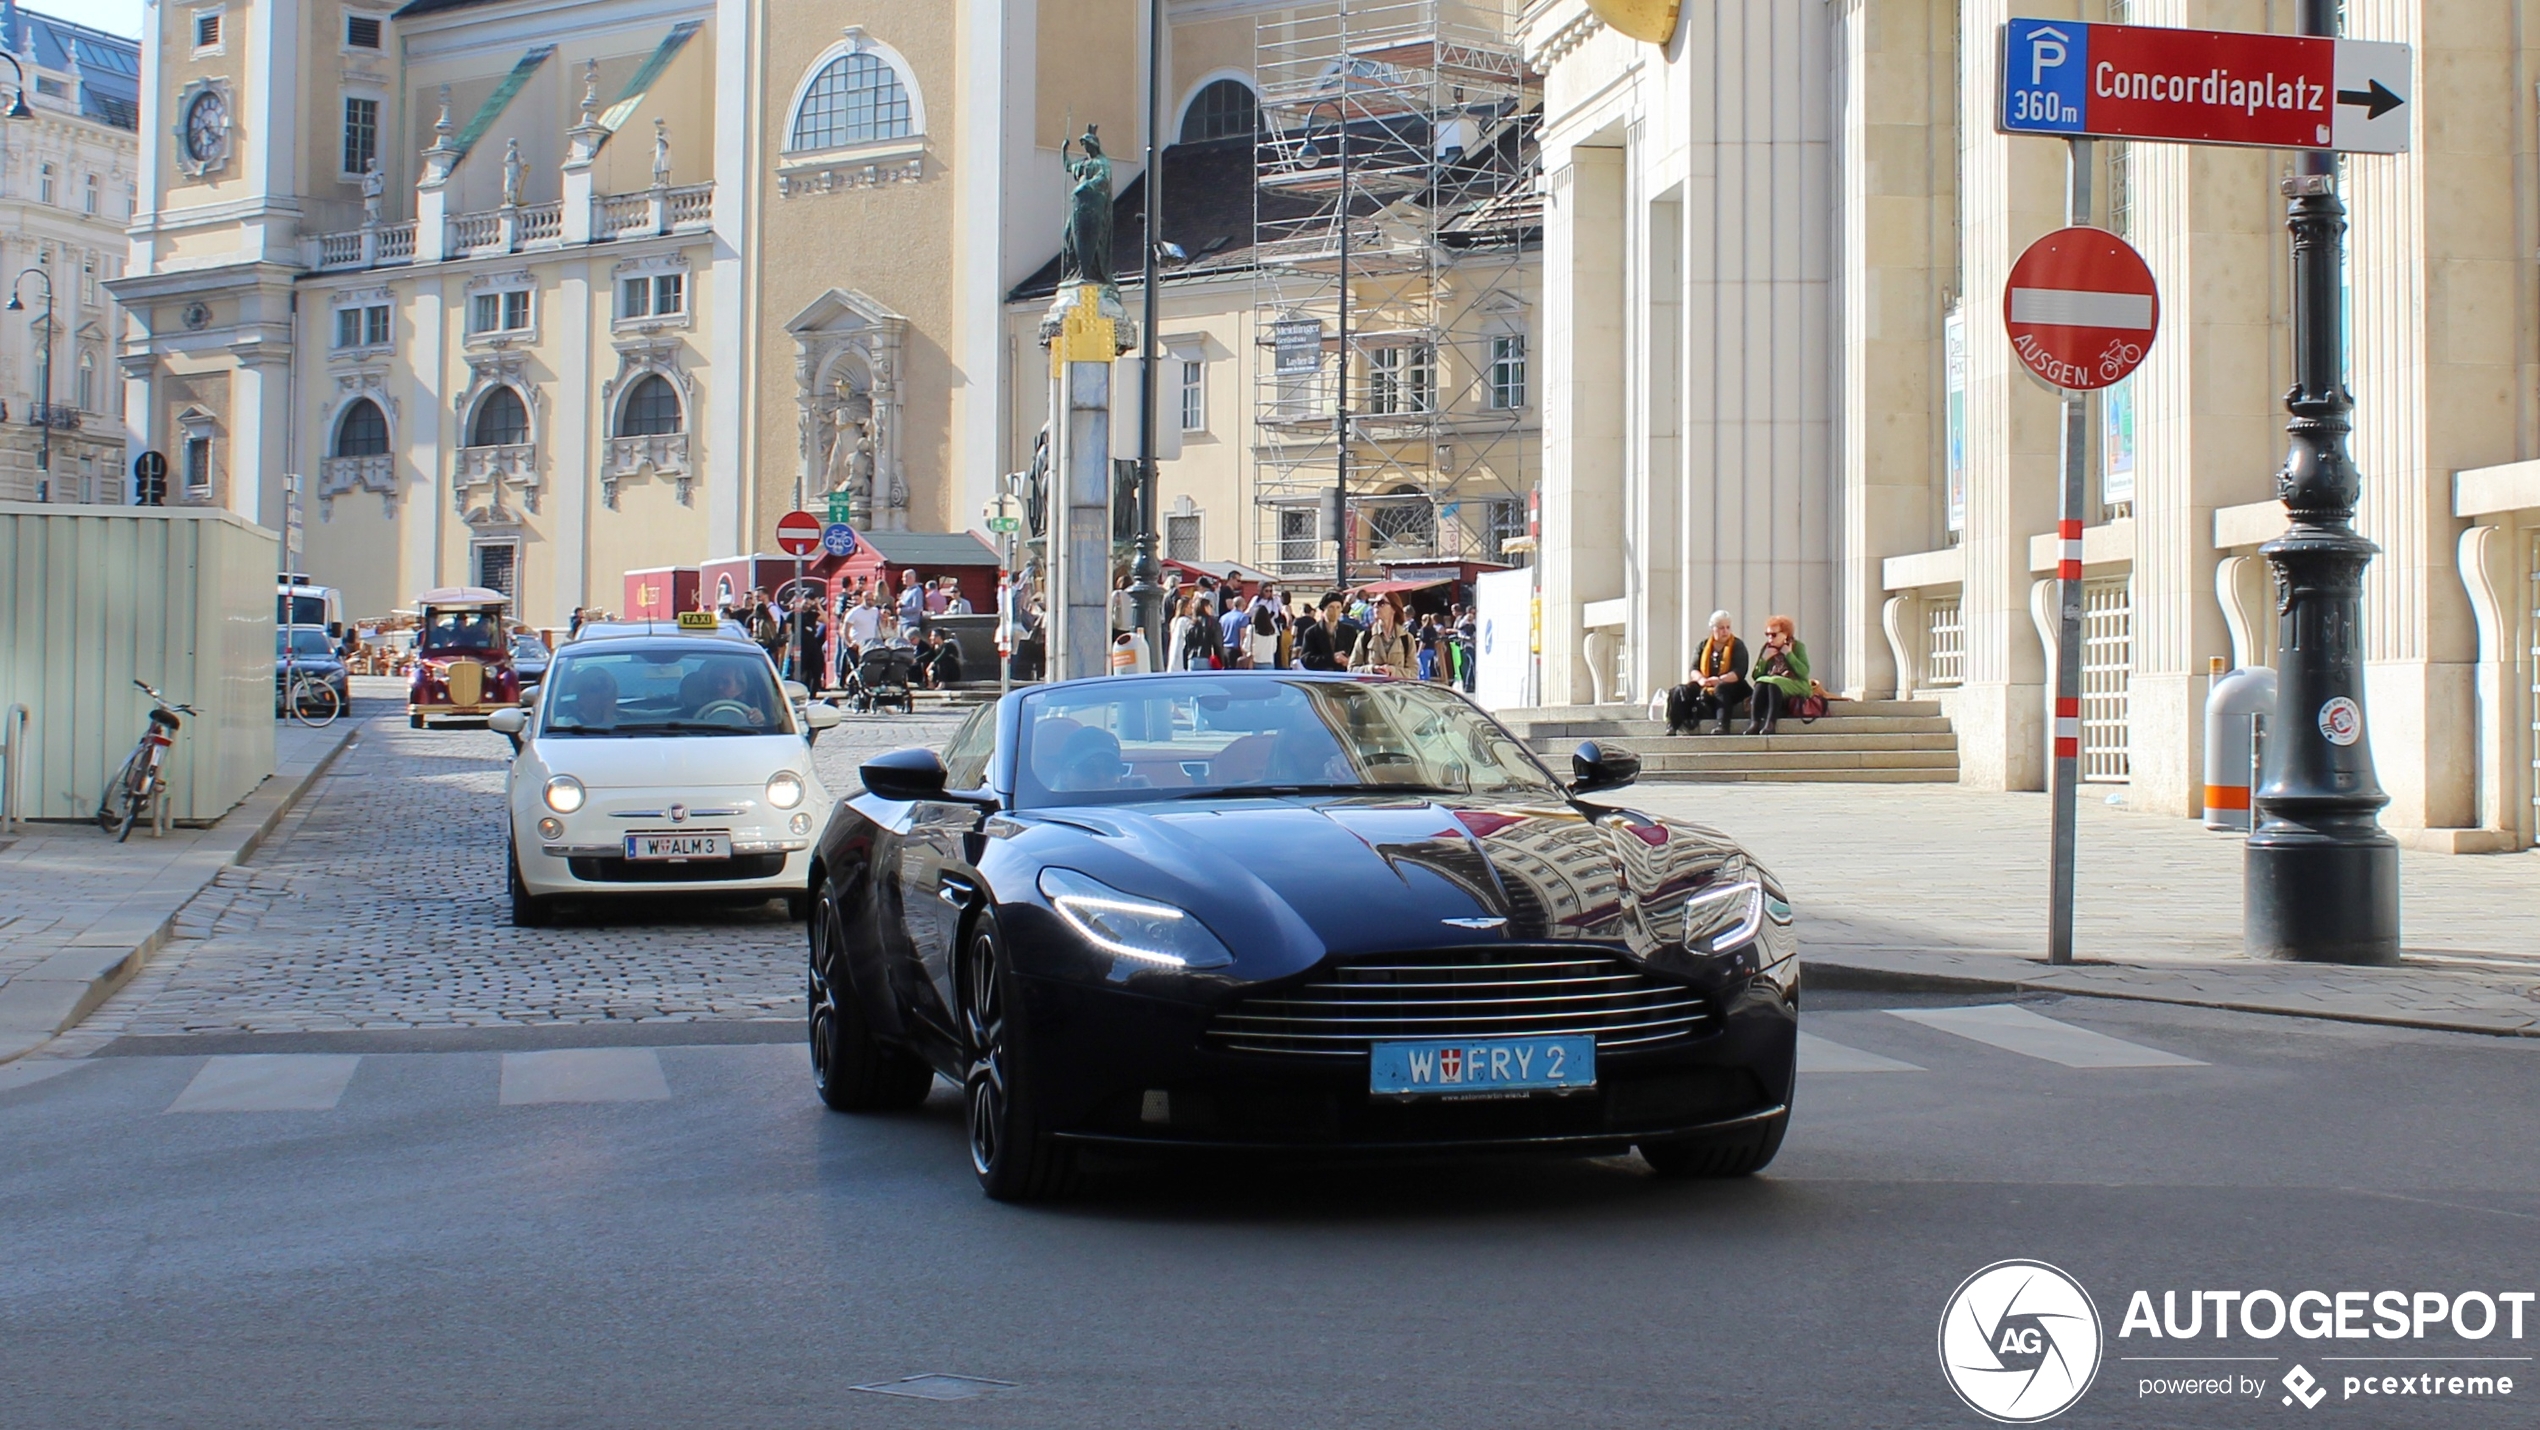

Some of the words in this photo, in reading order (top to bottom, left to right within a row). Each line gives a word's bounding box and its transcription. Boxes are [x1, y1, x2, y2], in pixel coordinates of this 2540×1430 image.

[2031, 40, 2067, 85] P
[2013, 89, 2079, 124] 360m
[2094, 61, 2325, 116] Concordiaplatz
[2013, 333, 2096, 387] AUSGEN.
[684, 614, 711, 624] TAXI
[648, 838, 659, 855] W
[671, 838, 702, 854] ALM
[705, 838, 715, 854] 3
[1408, 1049, 1434, 1085] W
[1466, 1045, 1536, 1081] FRY
[1546, 1045, 1567, 1080] 2
